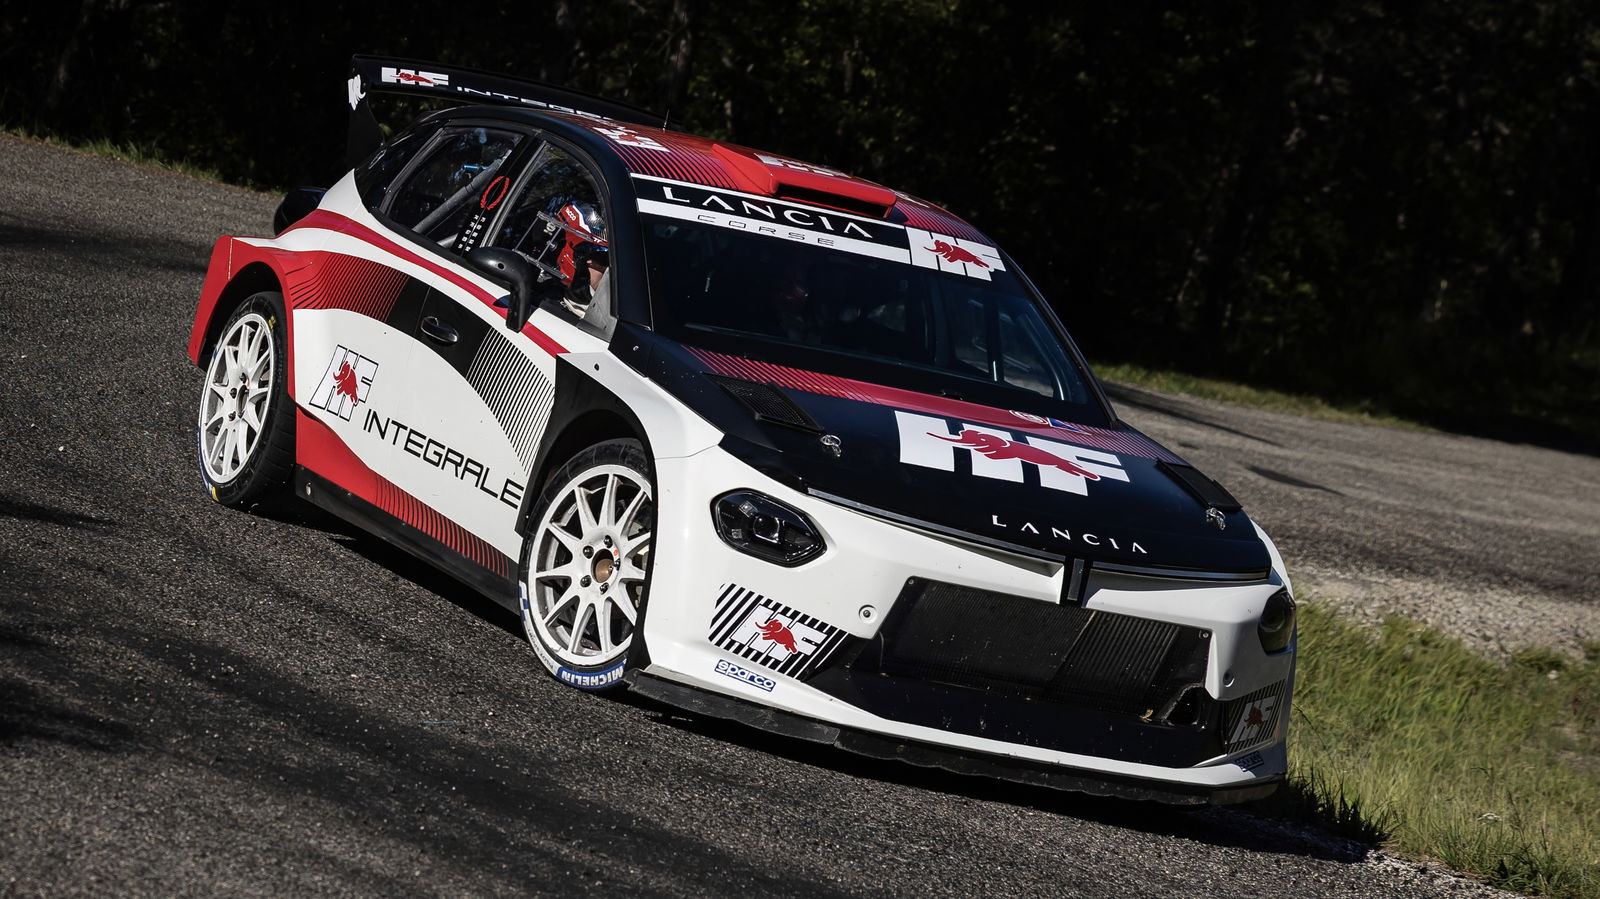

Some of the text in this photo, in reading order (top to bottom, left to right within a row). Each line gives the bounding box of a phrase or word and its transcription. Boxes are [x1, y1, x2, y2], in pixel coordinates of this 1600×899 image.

[381, 67, 449, 87] HF
[662, 186, 873, 239] LANCIA
[697, 214, 836, 247] CORSE
[905, 226, 1007, 281] HF
[308, 343, 379, 422] HF
[362, 408, 525, 510] INTEGRALE
[893, 410, 1131, 497] HF
[991, 513, 1148, 555] LANCIA
[729, 603, 829, 662] HF
[560, 665, 625, 687] MICHELIN
[716, 659, 776, 691] sparco
[1230, 695, 1277, 744] HF
